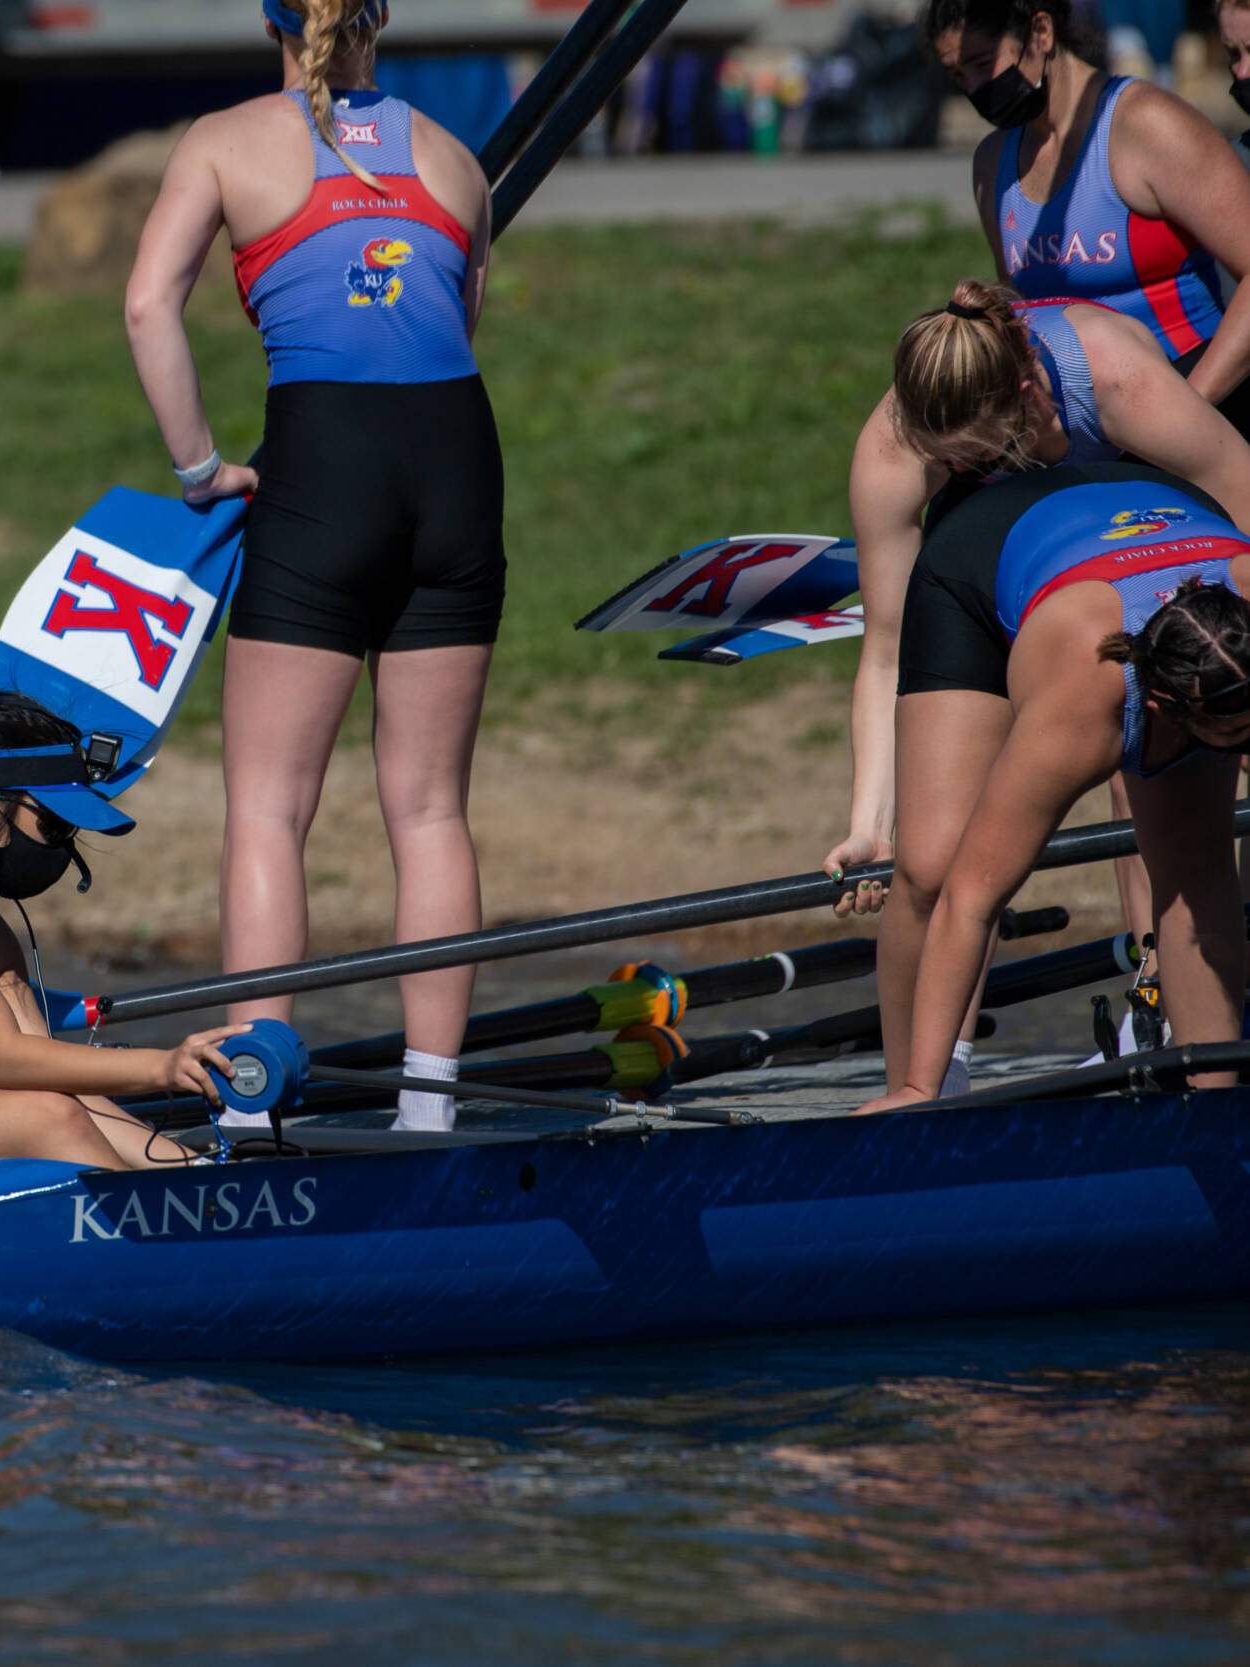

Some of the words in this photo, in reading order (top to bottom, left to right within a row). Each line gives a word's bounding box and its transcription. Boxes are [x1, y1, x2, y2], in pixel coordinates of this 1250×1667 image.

[337, 120, 381, 146] XII
[332, 199, 366, 211] ROCK
[368, 198, 408, 209] CHALK
[1004, 230, 1117, 275] ANSAS
[364, 273, 382, 288] KU
[1113, 547, 1165, 562] CHALK
[1168, 541, 1213, 552] ROCK
[642, 543, 807, 617] K
[41, 549, 195, 692] K
[69, 1177, 317, 1243] KANSAS
